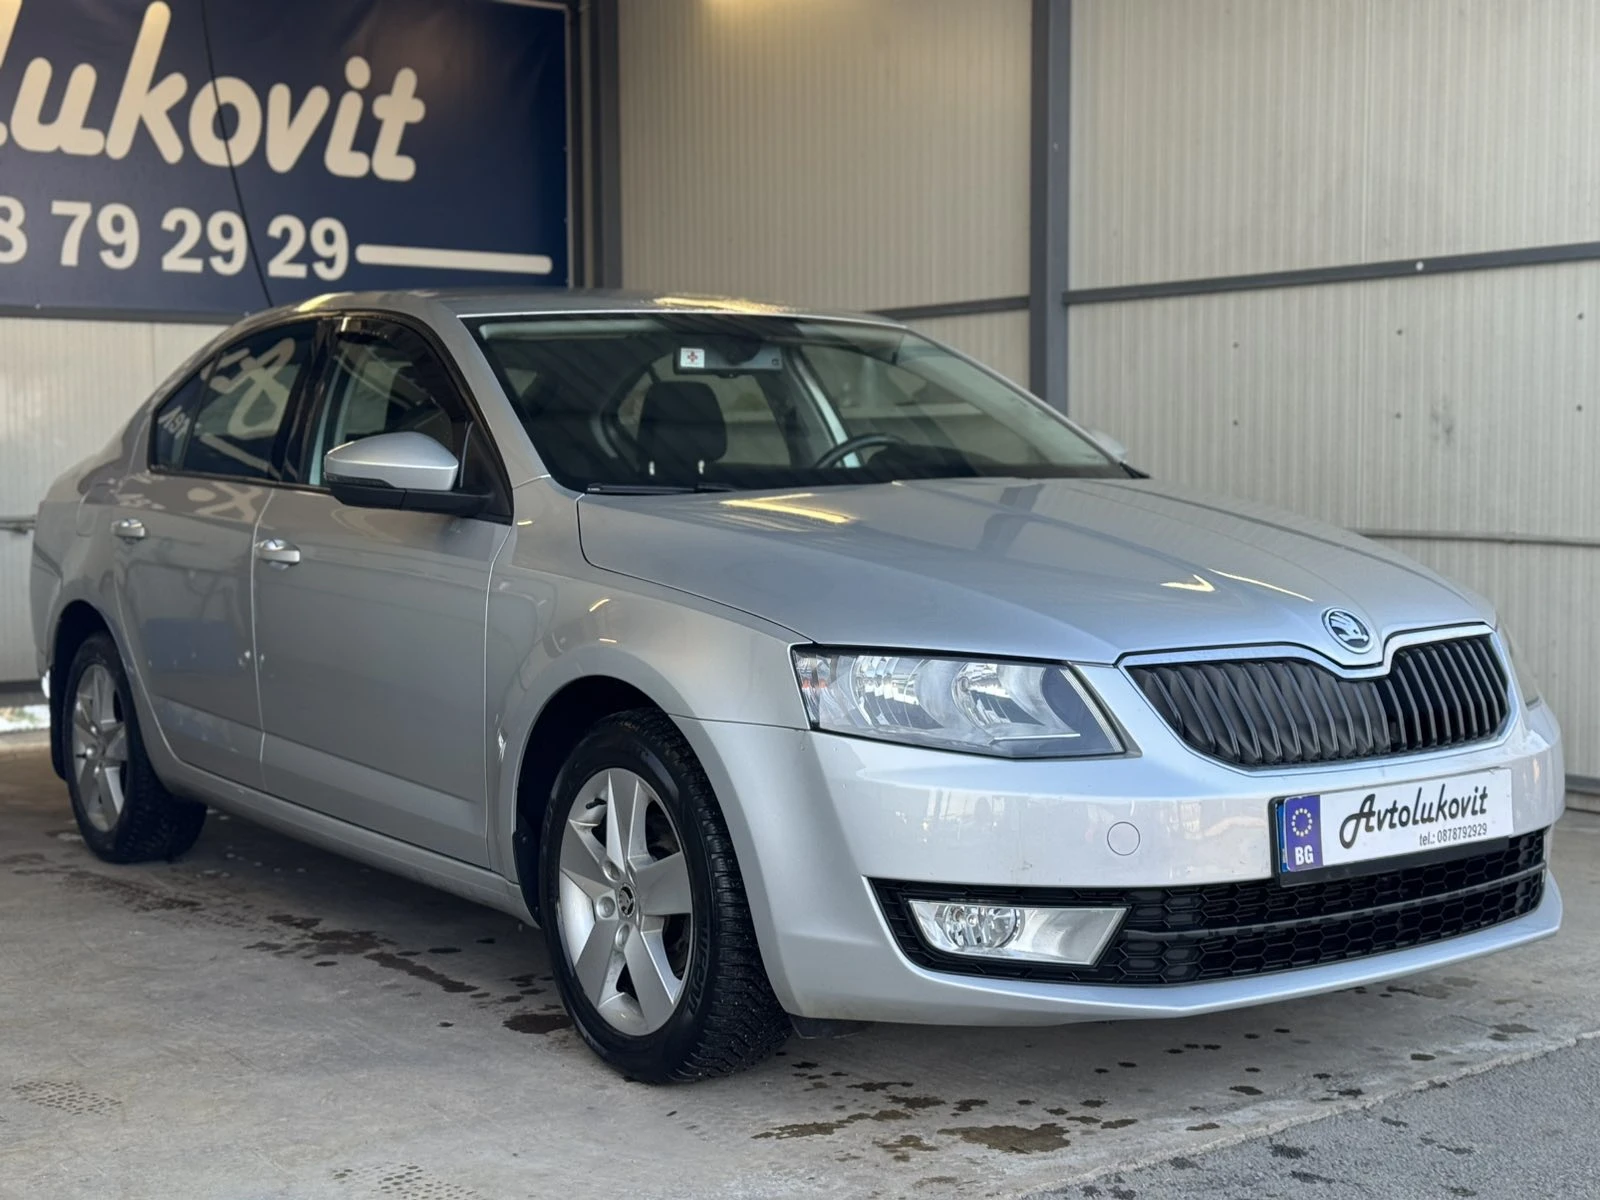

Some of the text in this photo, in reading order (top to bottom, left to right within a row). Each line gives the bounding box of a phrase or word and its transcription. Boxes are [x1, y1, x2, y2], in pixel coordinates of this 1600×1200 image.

[50, 199, 141, 270] 79
[160, 207, 249, 276] 29
[267, 214, 350, 281] 29
[1339, 783, 1489, 849] Avtolukovit
[1436, 822, 1488, 844] 0878792929
[1294, 845, 1316, 866] BG
